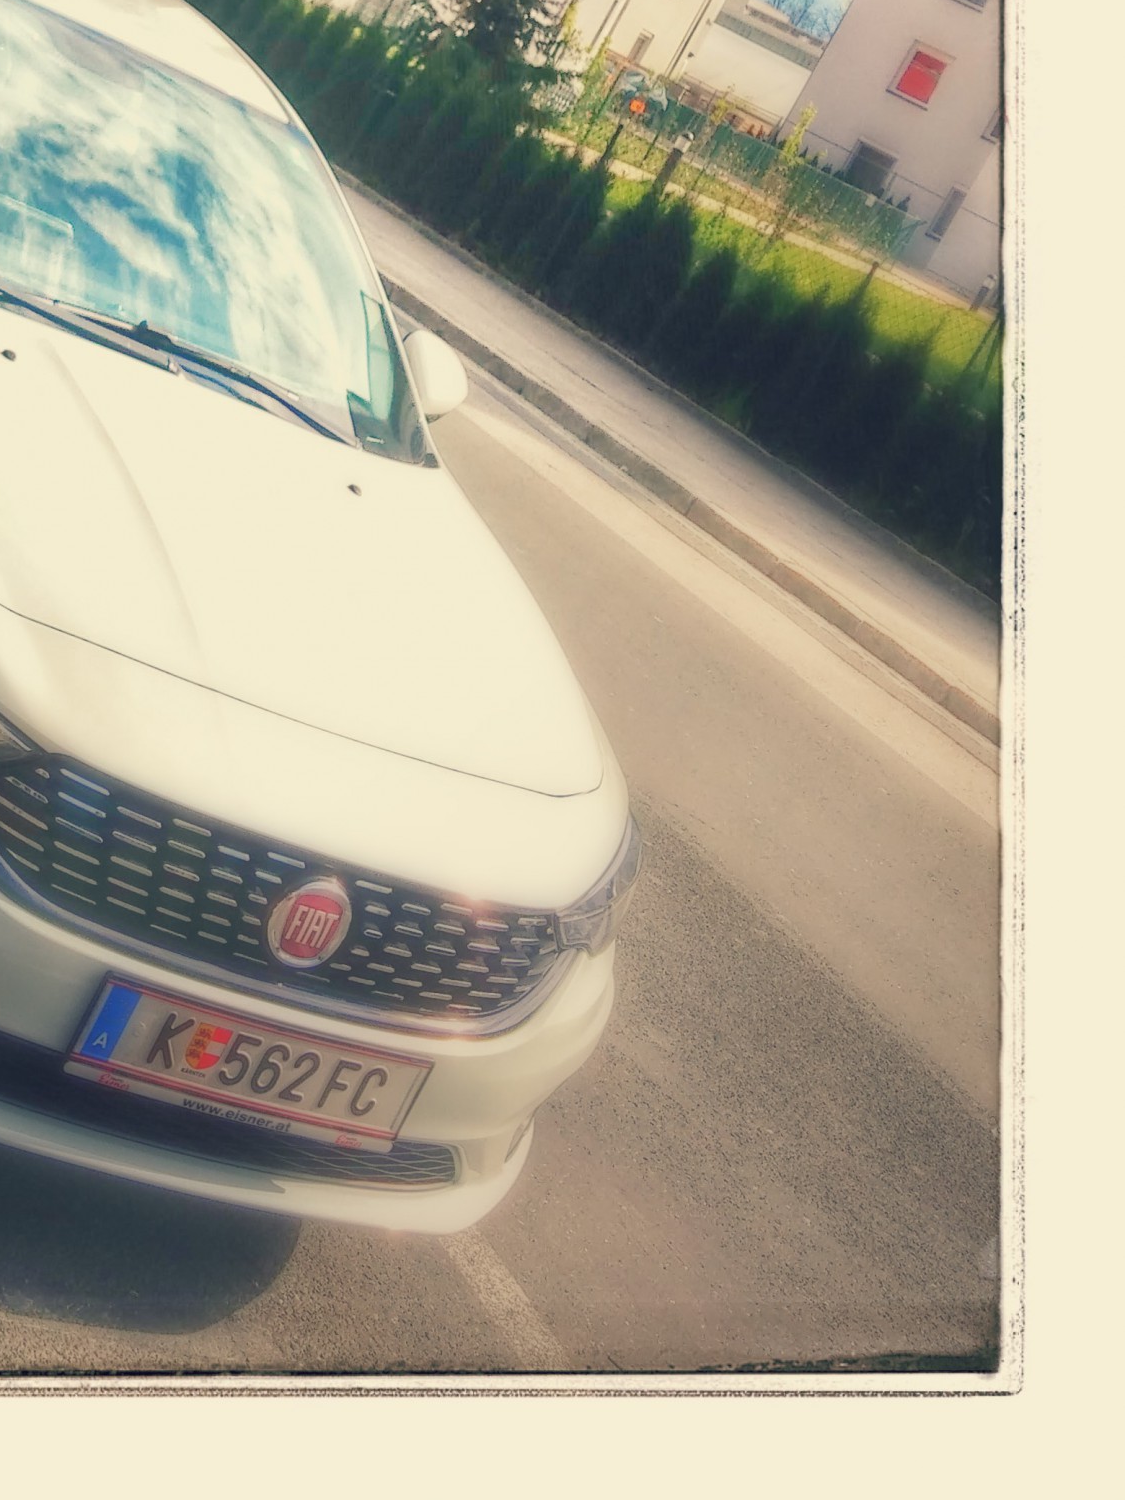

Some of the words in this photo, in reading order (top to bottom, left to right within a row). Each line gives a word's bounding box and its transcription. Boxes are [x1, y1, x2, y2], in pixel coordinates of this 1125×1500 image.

[285, 904, 339, 949] FIAT
[92, 1031, 108, 1049] A
[146, 1012, 194, 1069] K
[182, 1097, 291, 1133] www.eisner.at
